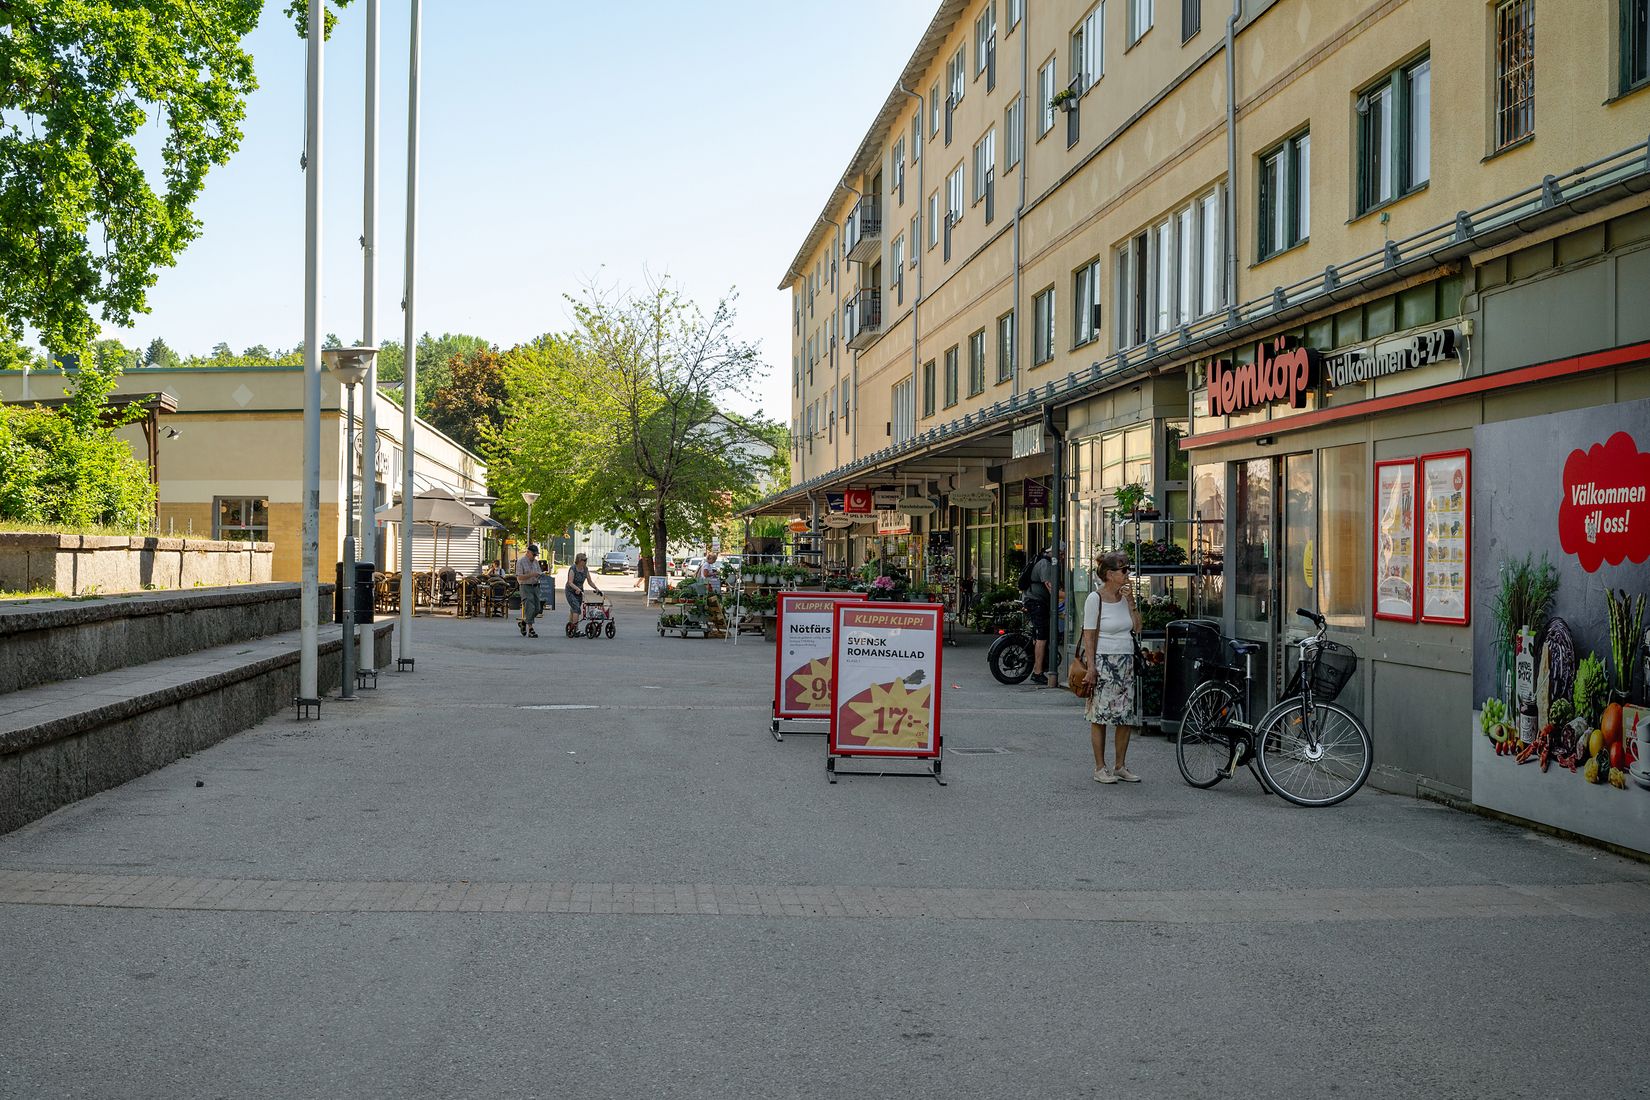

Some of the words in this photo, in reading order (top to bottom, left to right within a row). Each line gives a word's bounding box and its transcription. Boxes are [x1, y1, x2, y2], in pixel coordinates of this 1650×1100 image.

[1326, 348, 1406, 387] Välkommen
[1410, 329, 1446, 369] 8-22
[1207, 335, 1310, 417] Hemköp
[1571, 482, 1646, 506] Välkommen
[1584, 510, 1602, 534] till
[1603, 509, 1631, 533] oss!
[795, 602, 823, 610] KLIPP!
[854, 614, 888, 625] KLIPP!
[890, 616, 924, 626] KLIPP!
[790, 624, 831, 634] Nötfärs
[847, 637, 887, 647] SVENSK
[847, 647, 925, 659] ROMANSALLAD
